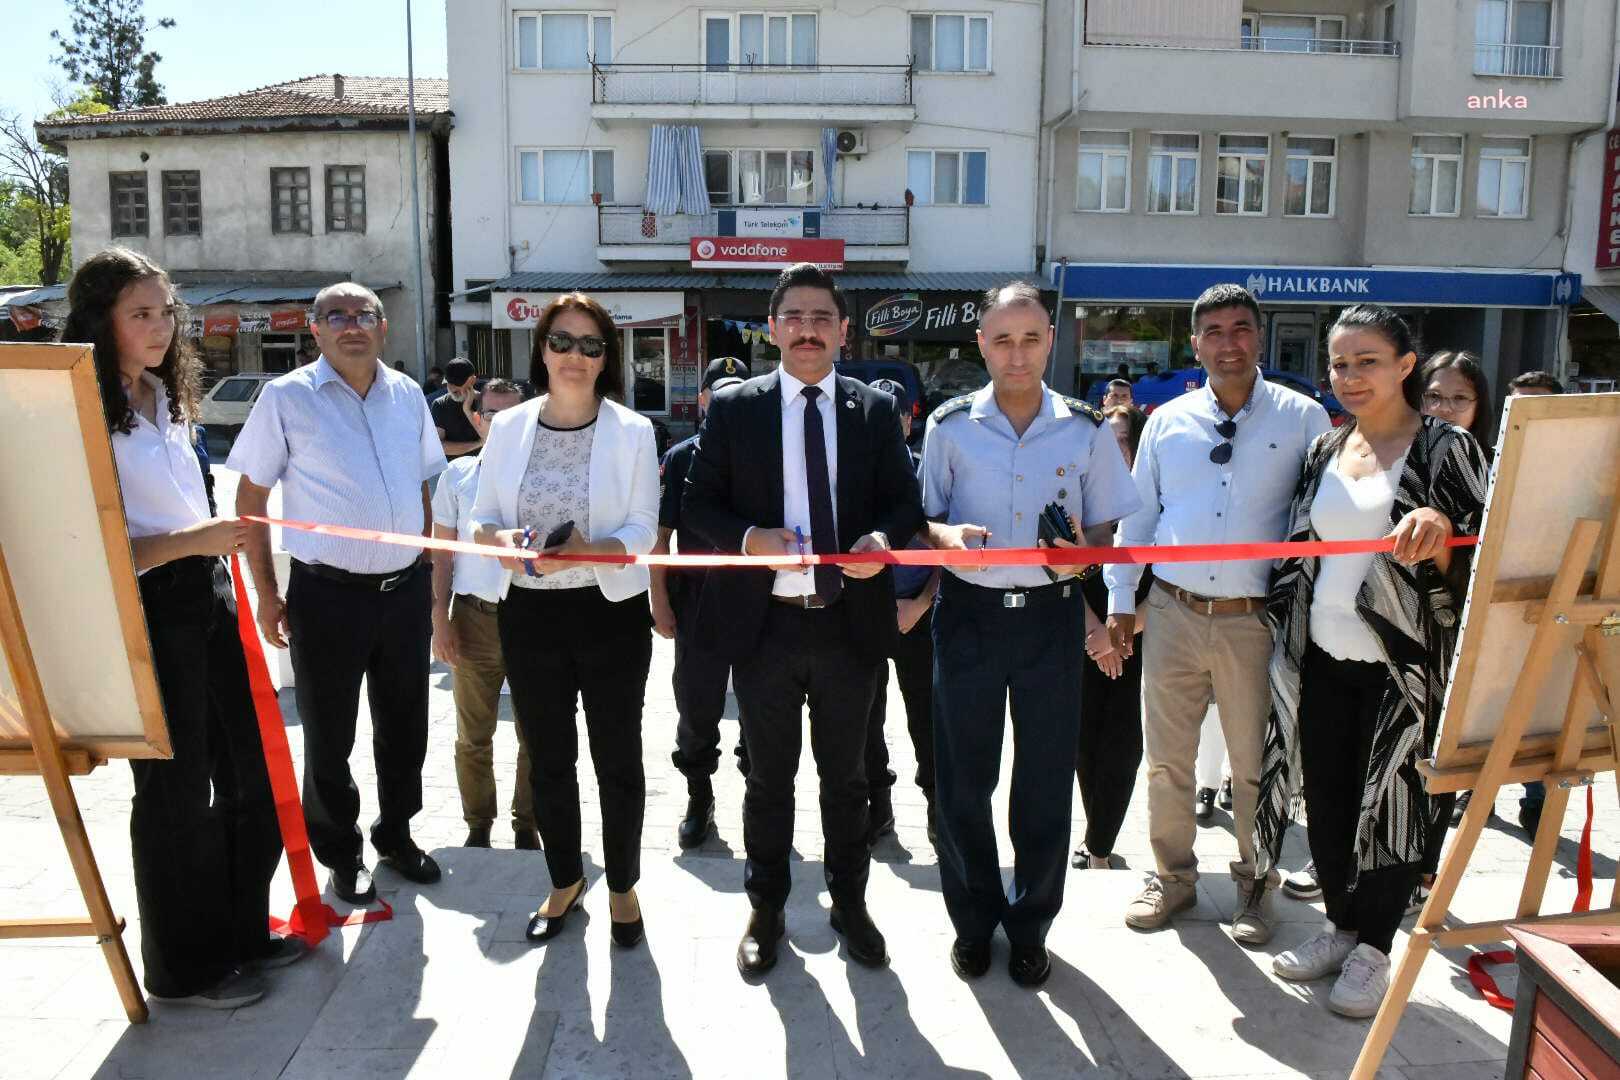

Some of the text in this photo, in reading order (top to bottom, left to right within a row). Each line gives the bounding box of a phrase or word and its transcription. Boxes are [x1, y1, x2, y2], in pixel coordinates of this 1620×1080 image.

[744, 219, 789, 229] Türk Telekom
[720, 244, 788, 256] vodafone
[1268, 277, 1370, 293] HALKBANK
[871, 305, 920, 325] Filli Boya
[924, 303, 958, 330] Filli
